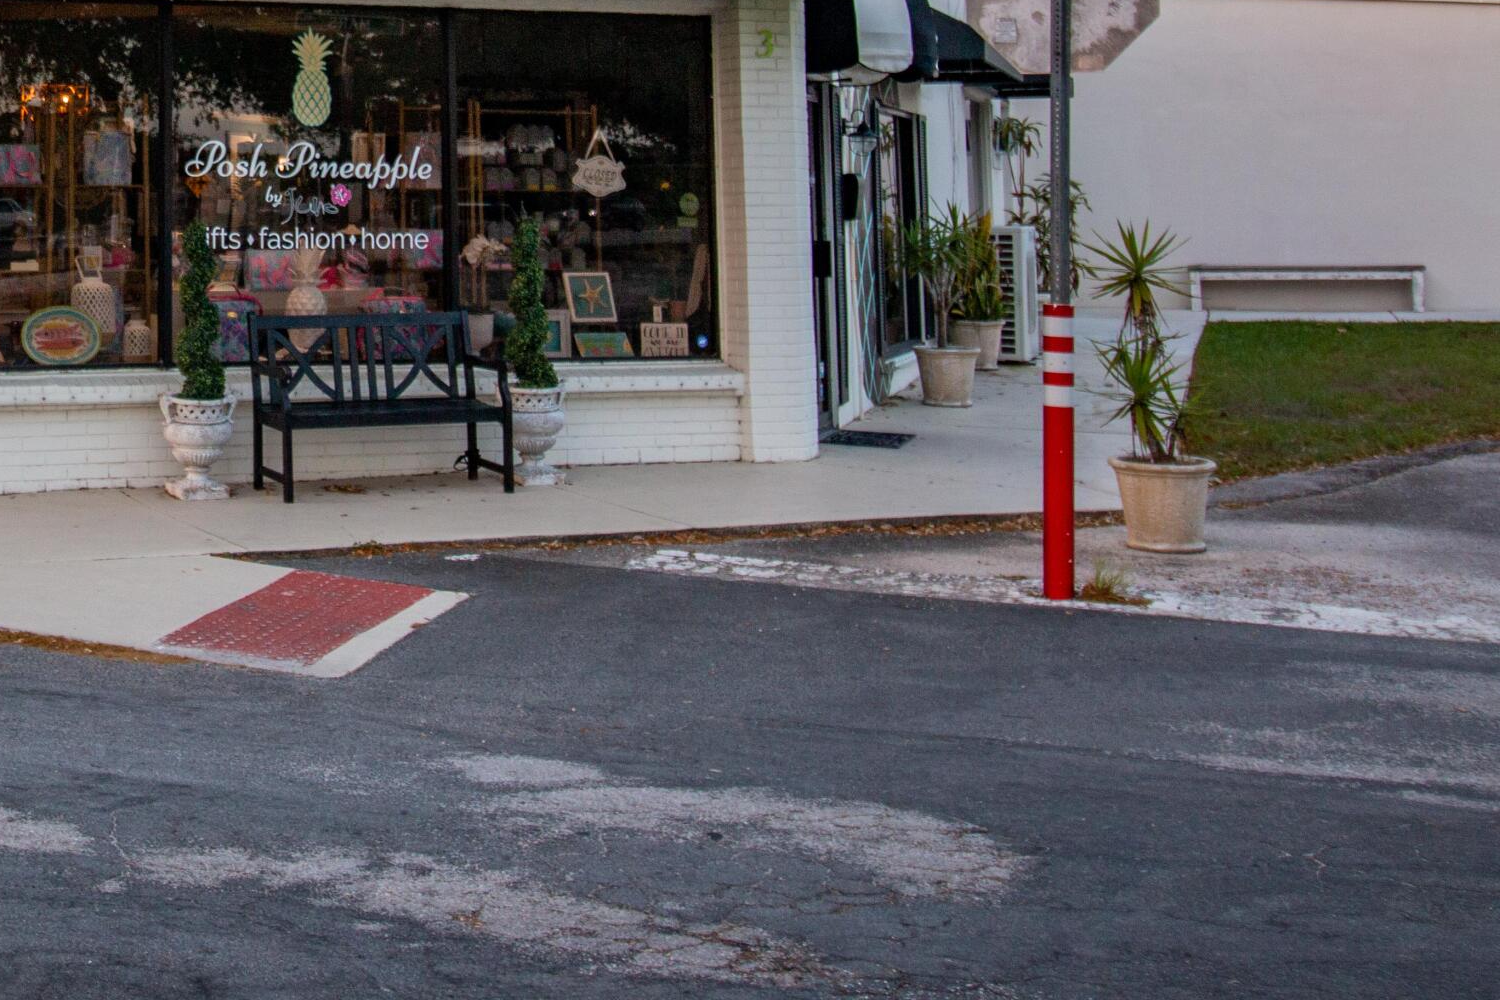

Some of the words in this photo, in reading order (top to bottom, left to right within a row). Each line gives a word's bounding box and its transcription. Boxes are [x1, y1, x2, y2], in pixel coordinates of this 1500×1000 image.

[755, 28, 774, 59] 3
[184, 140, 268, 178] Posh
[275, 141, 433, 189] Pineapple
[264, 185, 283, 208] by
[204, 226, 242, 250] ifts
[258, 226, 346, 250] fashion
[361, 227, 430, 250] home
